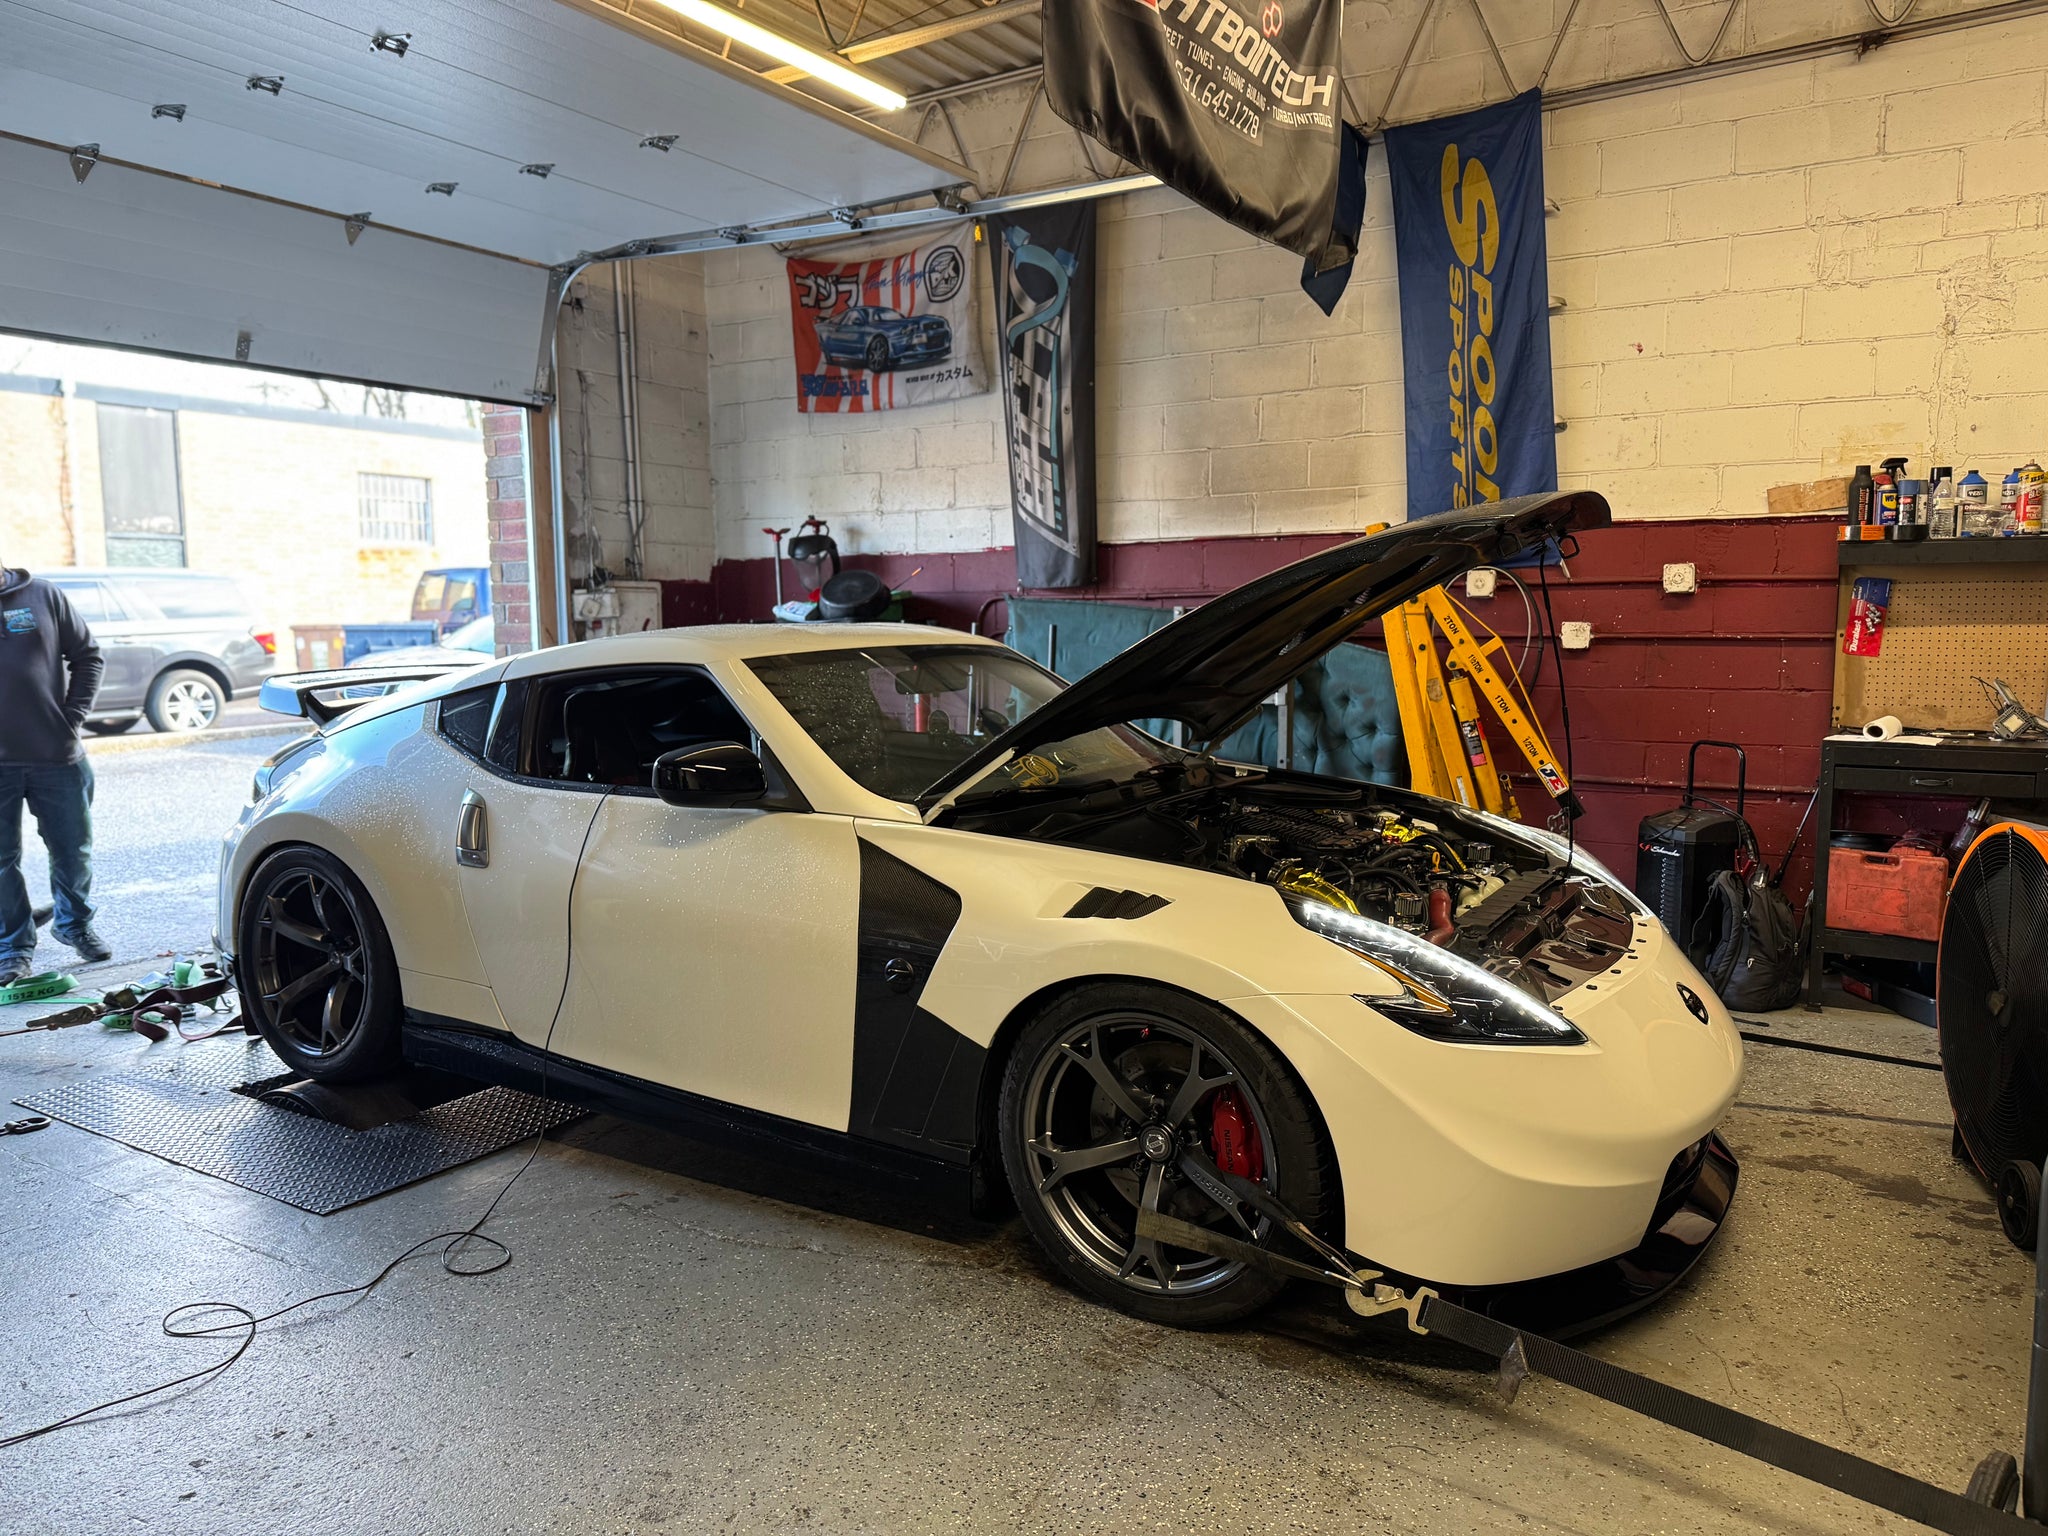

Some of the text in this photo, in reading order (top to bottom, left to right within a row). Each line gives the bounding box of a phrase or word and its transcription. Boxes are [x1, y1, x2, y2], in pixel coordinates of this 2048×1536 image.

[1187, 40, 1215, 71] TUNES
[1222, 65, 1246, 93] ENGINE
[1849, 620, 1861, 652] Duralast
[8, 991, 34, 1000] 1512
[38, 986, 55, 996] KG
[1224, 1129, 1234, 1171] NISSAN
